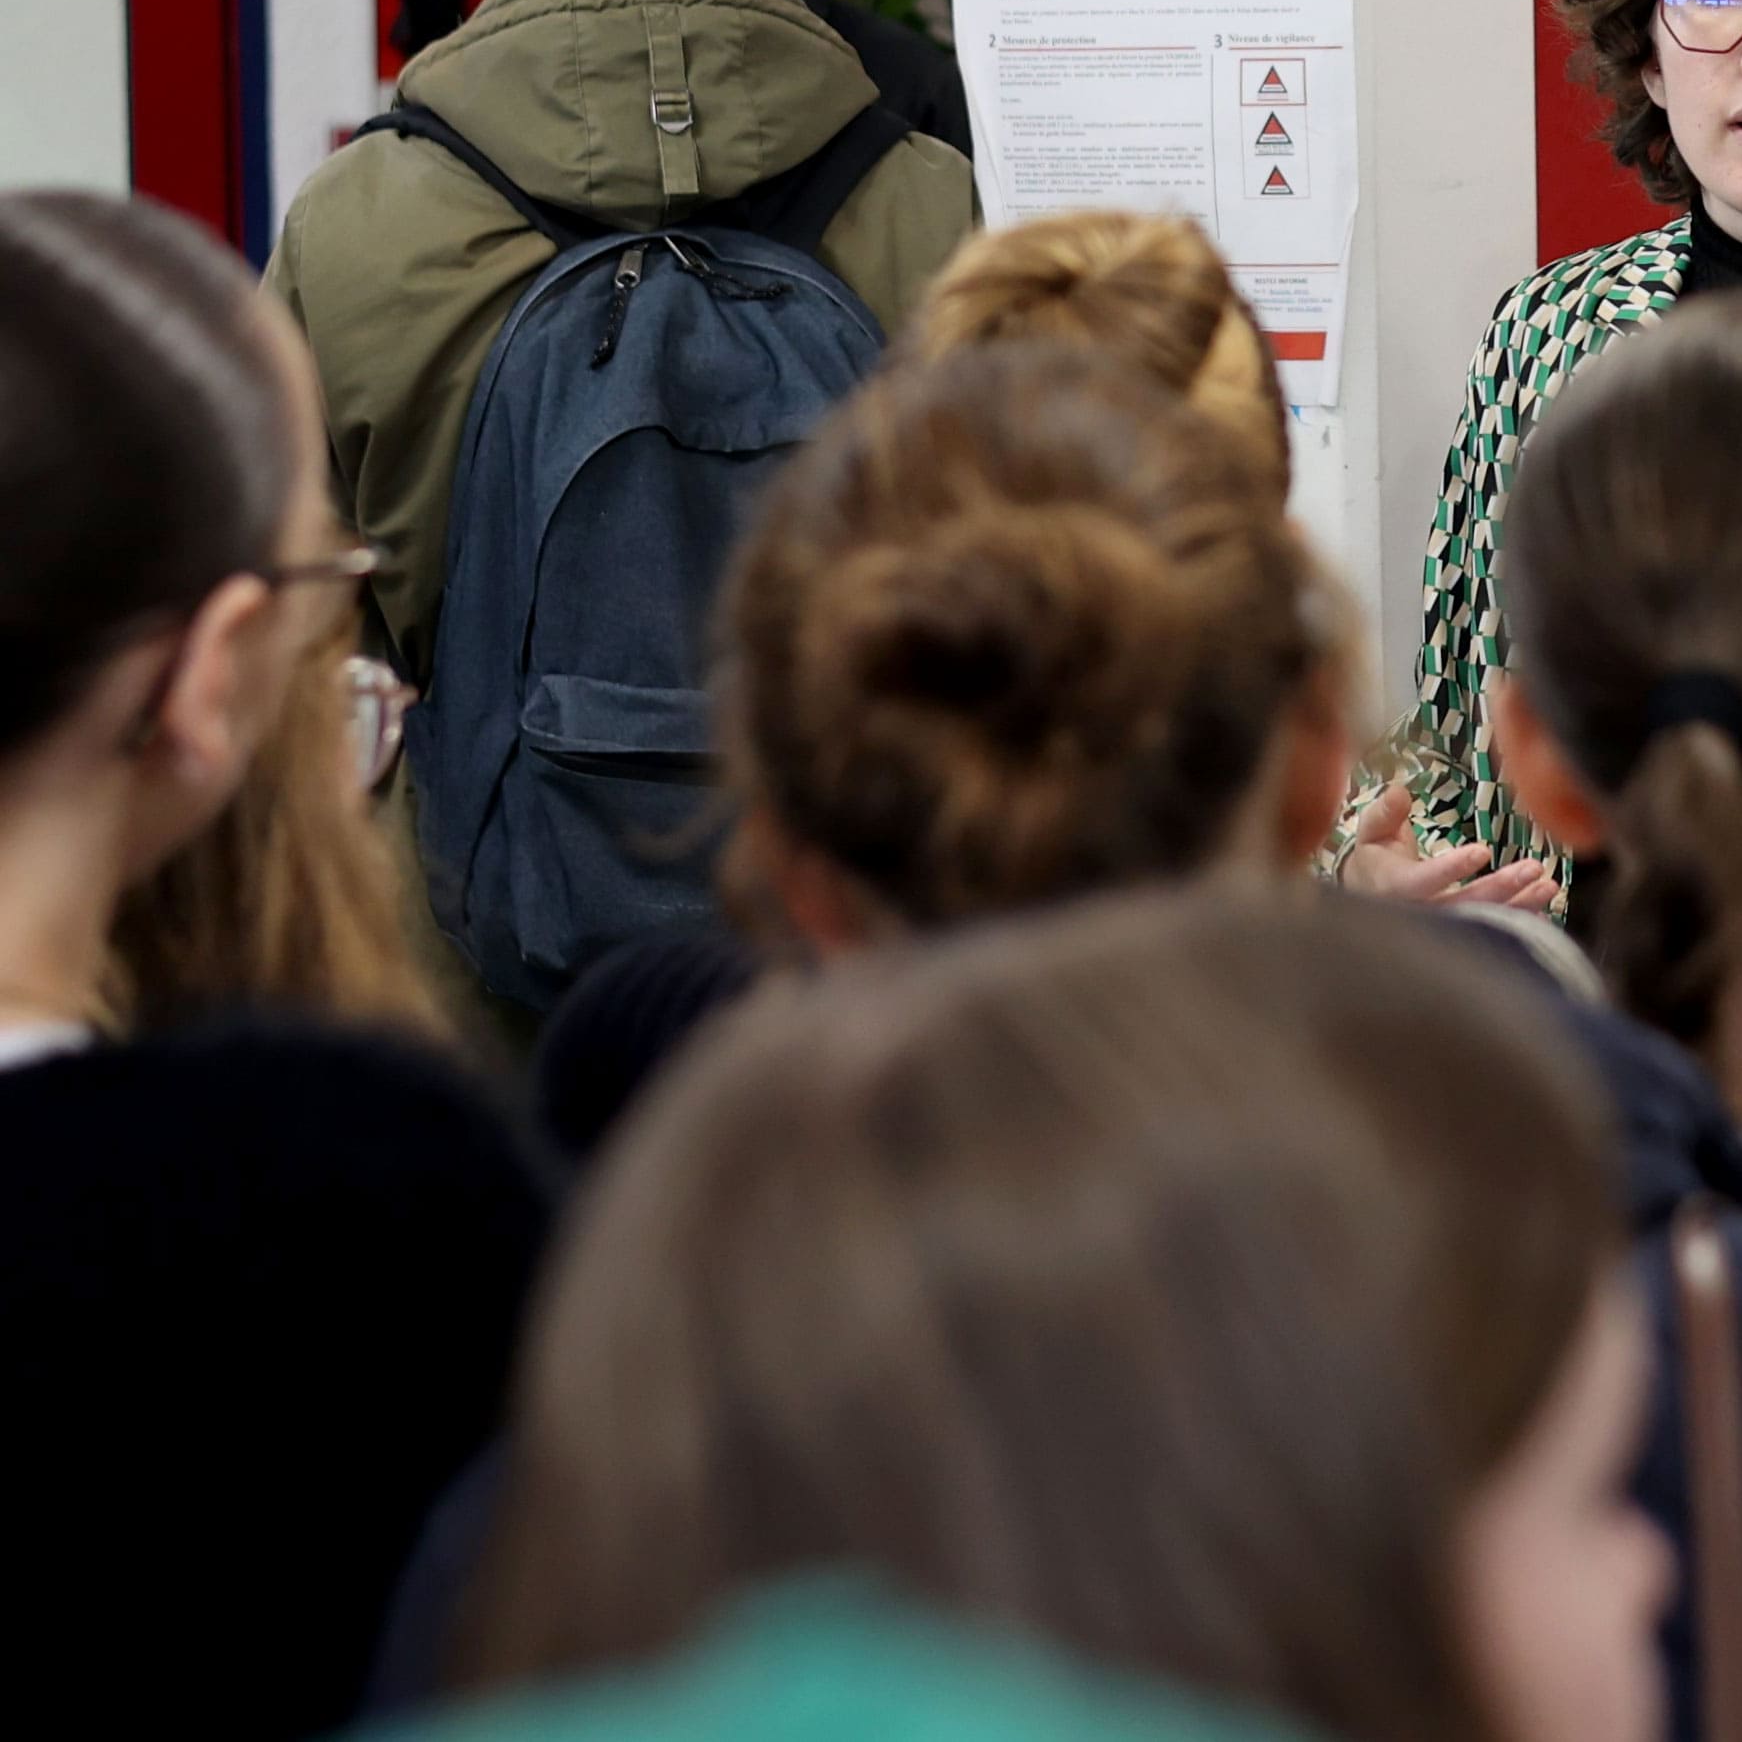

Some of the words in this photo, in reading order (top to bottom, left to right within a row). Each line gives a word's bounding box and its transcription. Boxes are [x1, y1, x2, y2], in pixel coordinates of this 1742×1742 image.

[989, 33, 997, 48] 2
[1002, 35, 1037, 46] Mesures
[1039, 35, 1049, 45] de
[1051, 35, 1097, 47] protection
[1214, 33, 1223, 49] 3
[1228, 33, 1260, 43] Niveau
[1262, 33, 1273, 43] de
[1275, 32, 1316, 45] vigilance
